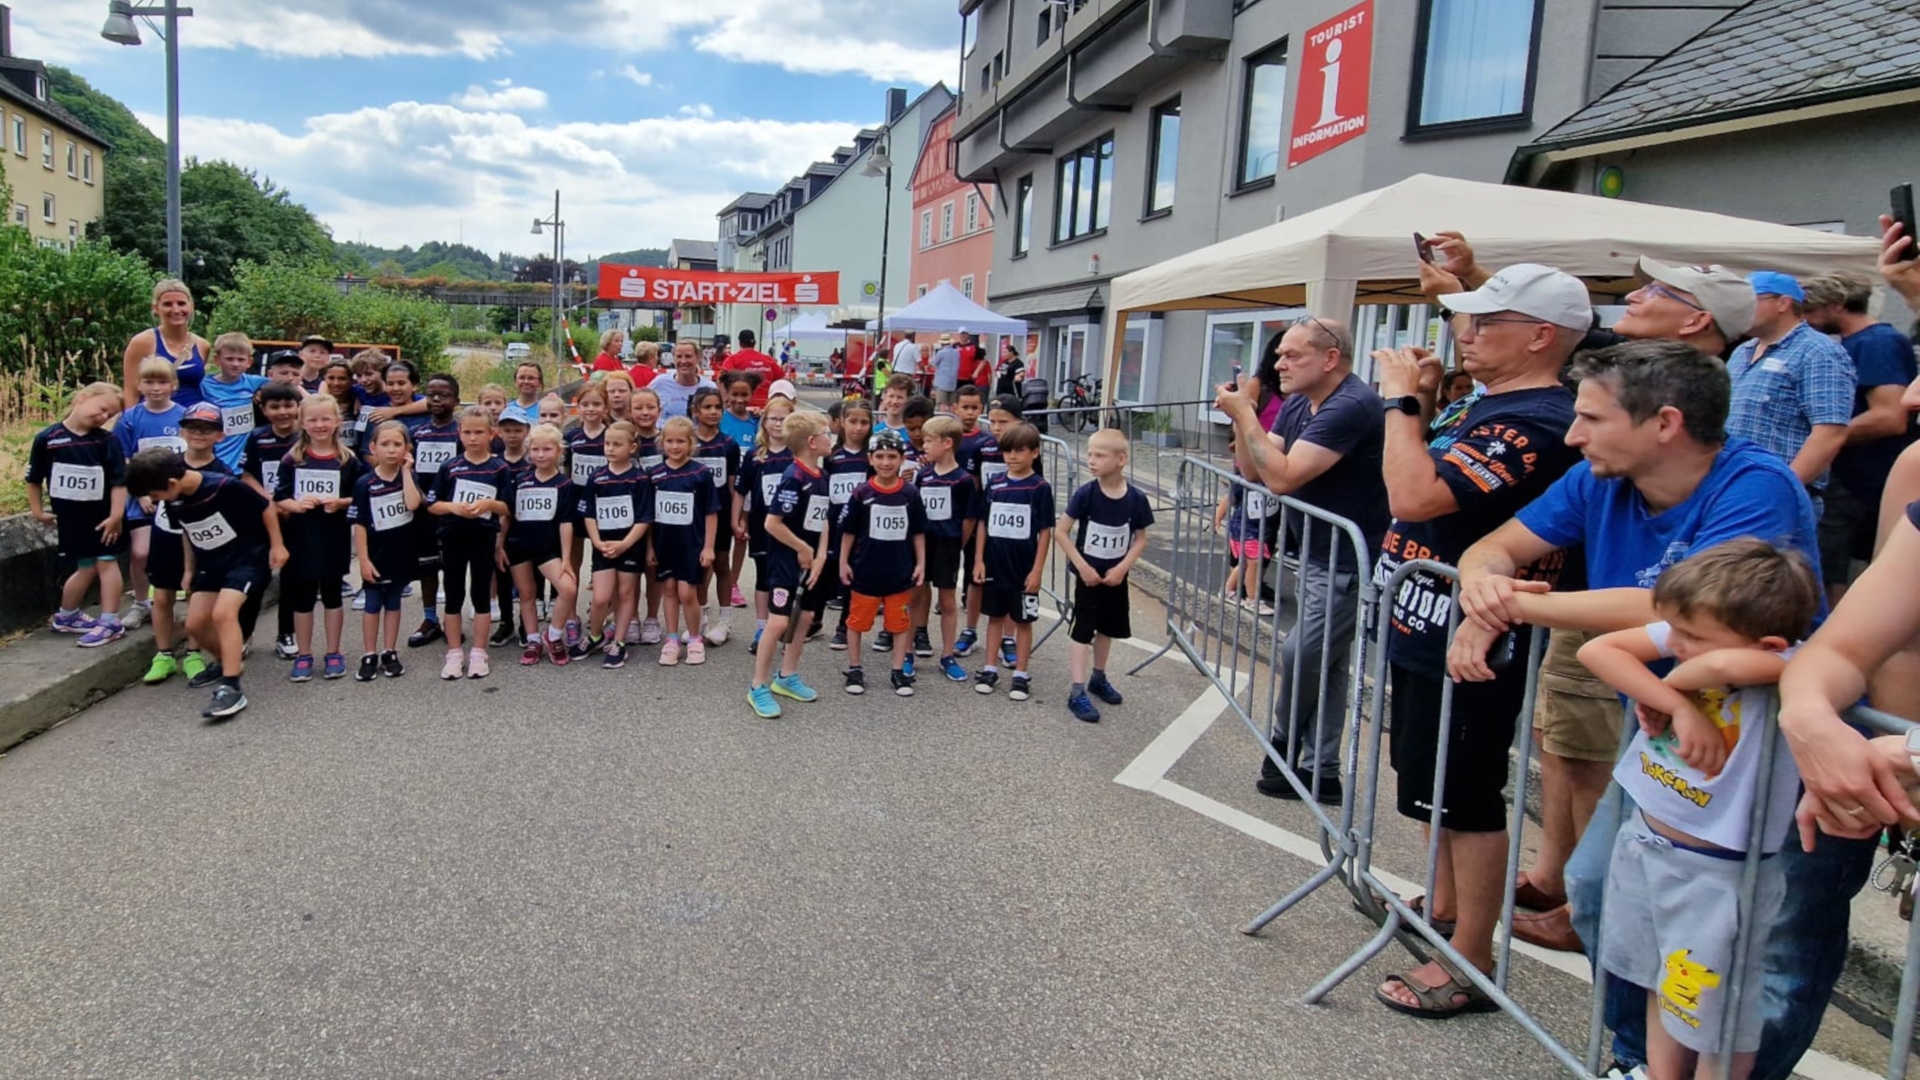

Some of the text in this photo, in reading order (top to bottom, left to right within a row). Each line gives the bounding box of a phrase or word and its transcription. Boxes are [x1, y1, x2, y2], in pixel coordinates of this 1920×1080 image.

[1310, 11, 1365, 47] TOURIST
[1292, 115, 1365, 149] INFORMATION
[227, 412, 253, 427] 3057
[420, 451, 451, 463] 2122
[58, 474, 96, 490] 1051
[299, 480, 334, 493] 1063
[833, 482, 860, 494] 210
[378, 503, 408, 519] 106
[520, 498, 552, 511] 1058
[659, 501, 688, 515] 1065
[599, 505, 628, 519] 2106
[876, 515, 906, 529] 1055
[992, 513, 1025, 528] 1049
[1091, 533, 1125, 549] 2111
